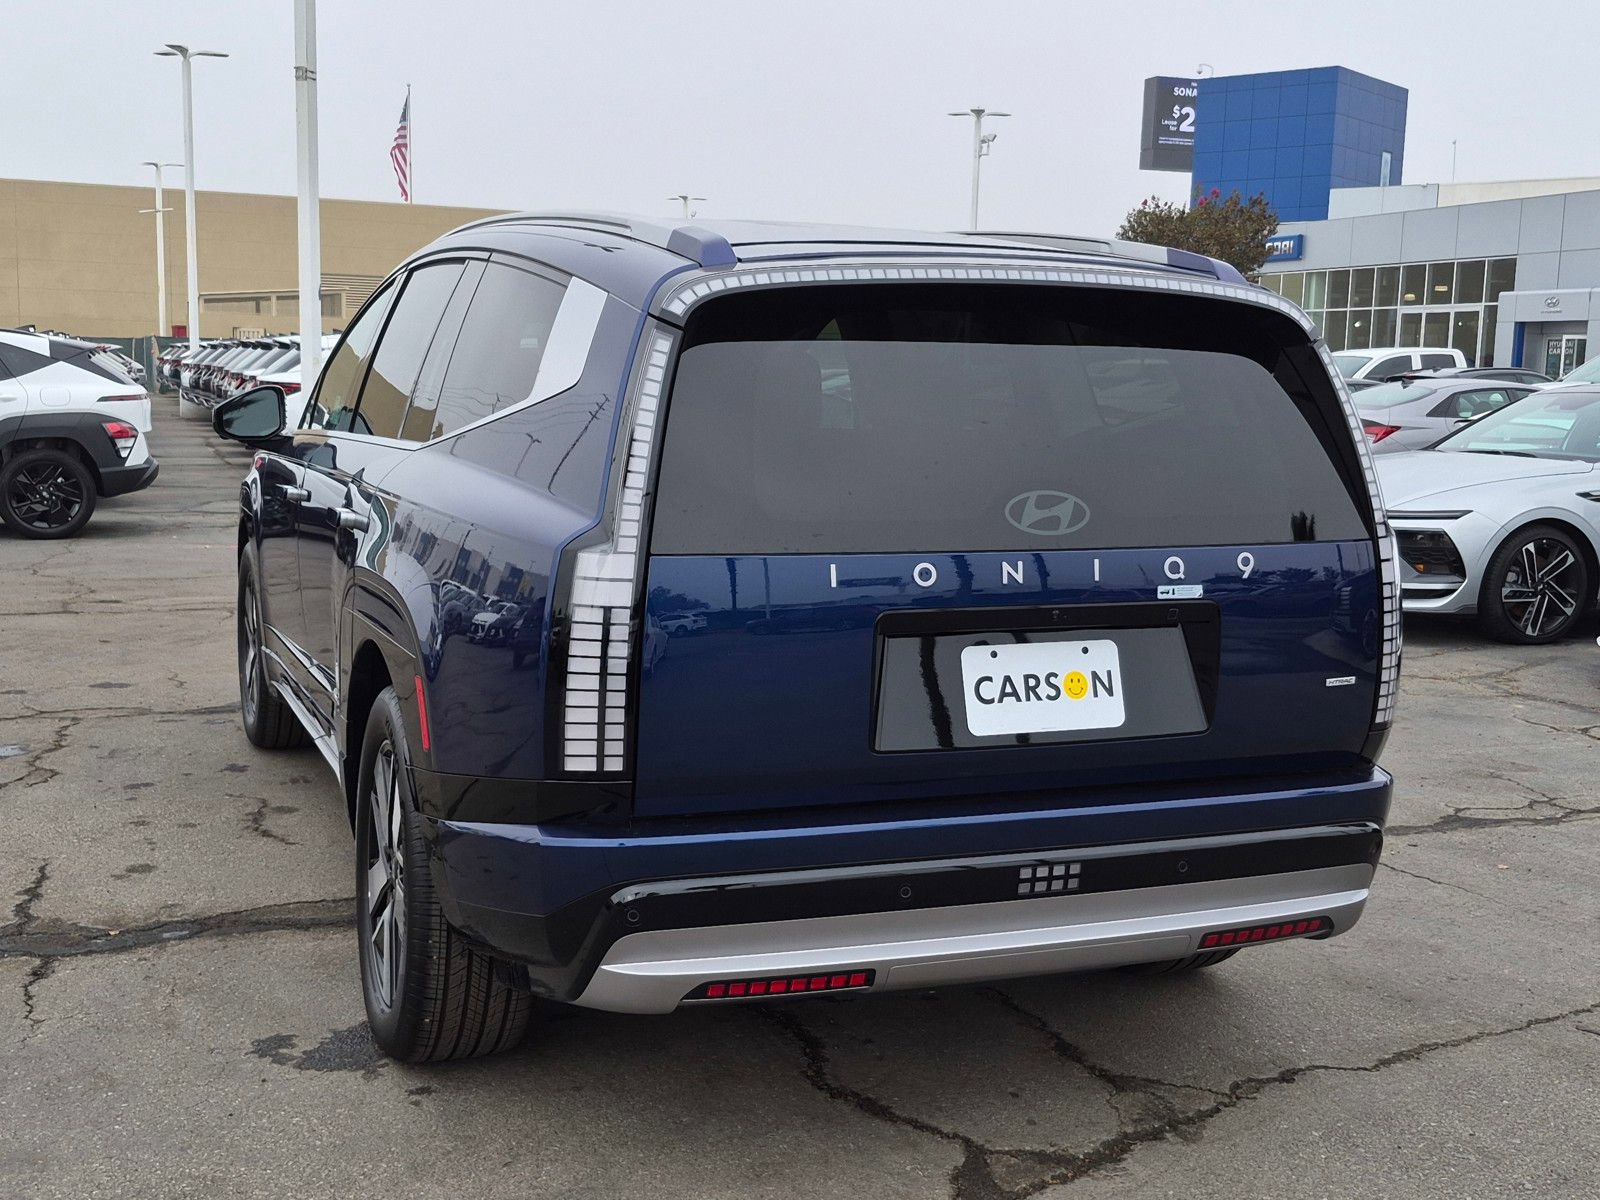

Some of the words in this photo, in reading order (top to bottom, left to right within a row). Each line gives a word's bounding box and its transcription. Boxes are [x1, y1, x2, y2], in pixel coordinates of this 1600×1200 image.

[830, 555, 1186, 588] IONIQ
[1236, 551, 1255, 579] 9
[973, 669, 1115, 705] CARSON
